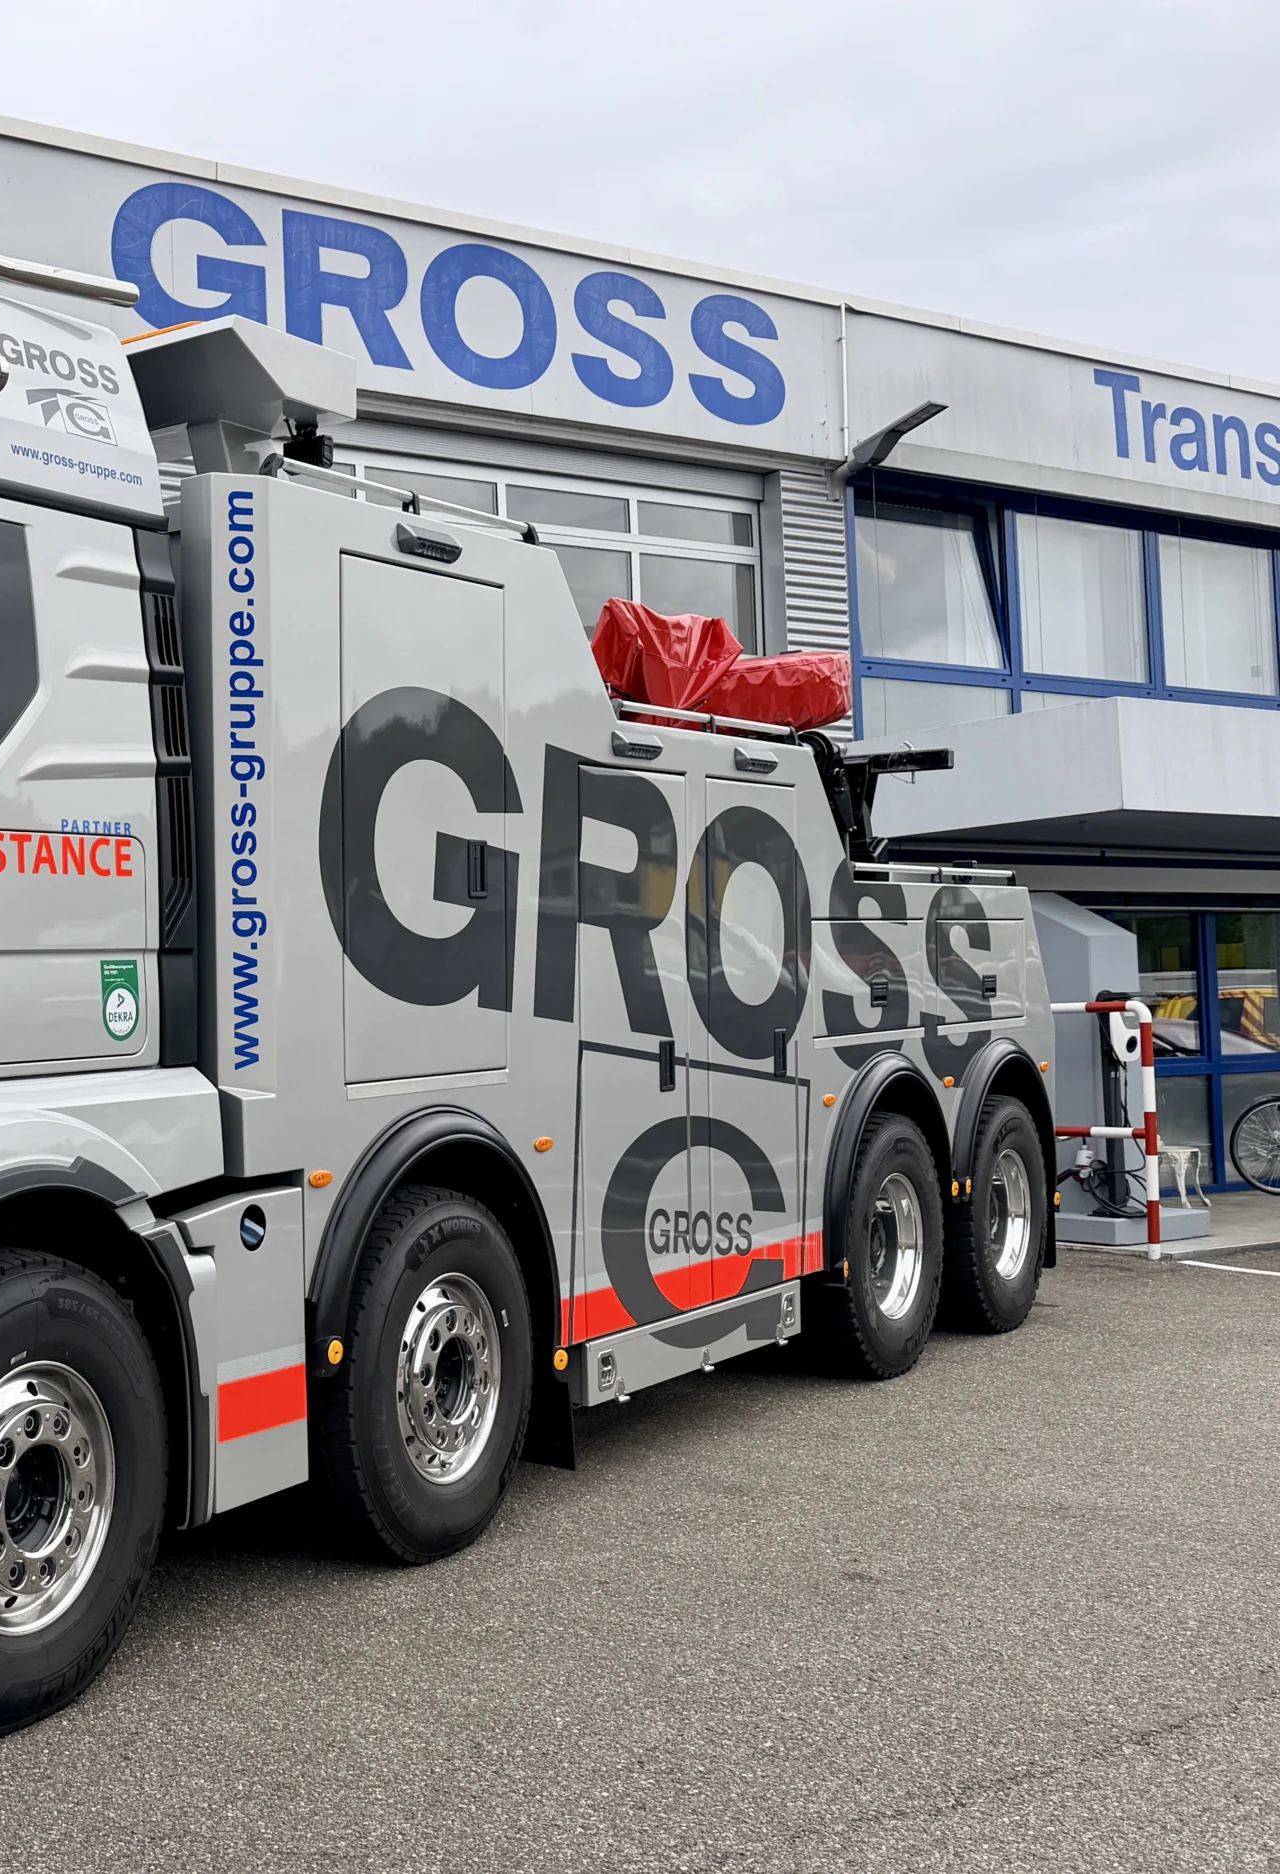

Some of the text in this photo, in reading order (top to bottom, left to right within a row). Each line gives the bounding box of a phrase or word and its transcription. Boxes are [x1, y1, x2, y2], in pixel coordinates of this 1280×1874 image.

[111, 181, 786, 425] GROSS
[75, 413, 100, 426] GROSS
[11, 443, 143, 486] www.gross-gruppe.com
[228, 490, 267, 1071] www.gross-gruppe.com
[61, 819, 132, 836] PARTNER
[319, 686, 991, 1088] GROSS
[108, 1011, 134, 1023] DEKRA
[441, 1218, 481, 1234] WORKS
[649, 1208, 753, 1257] GROSS
